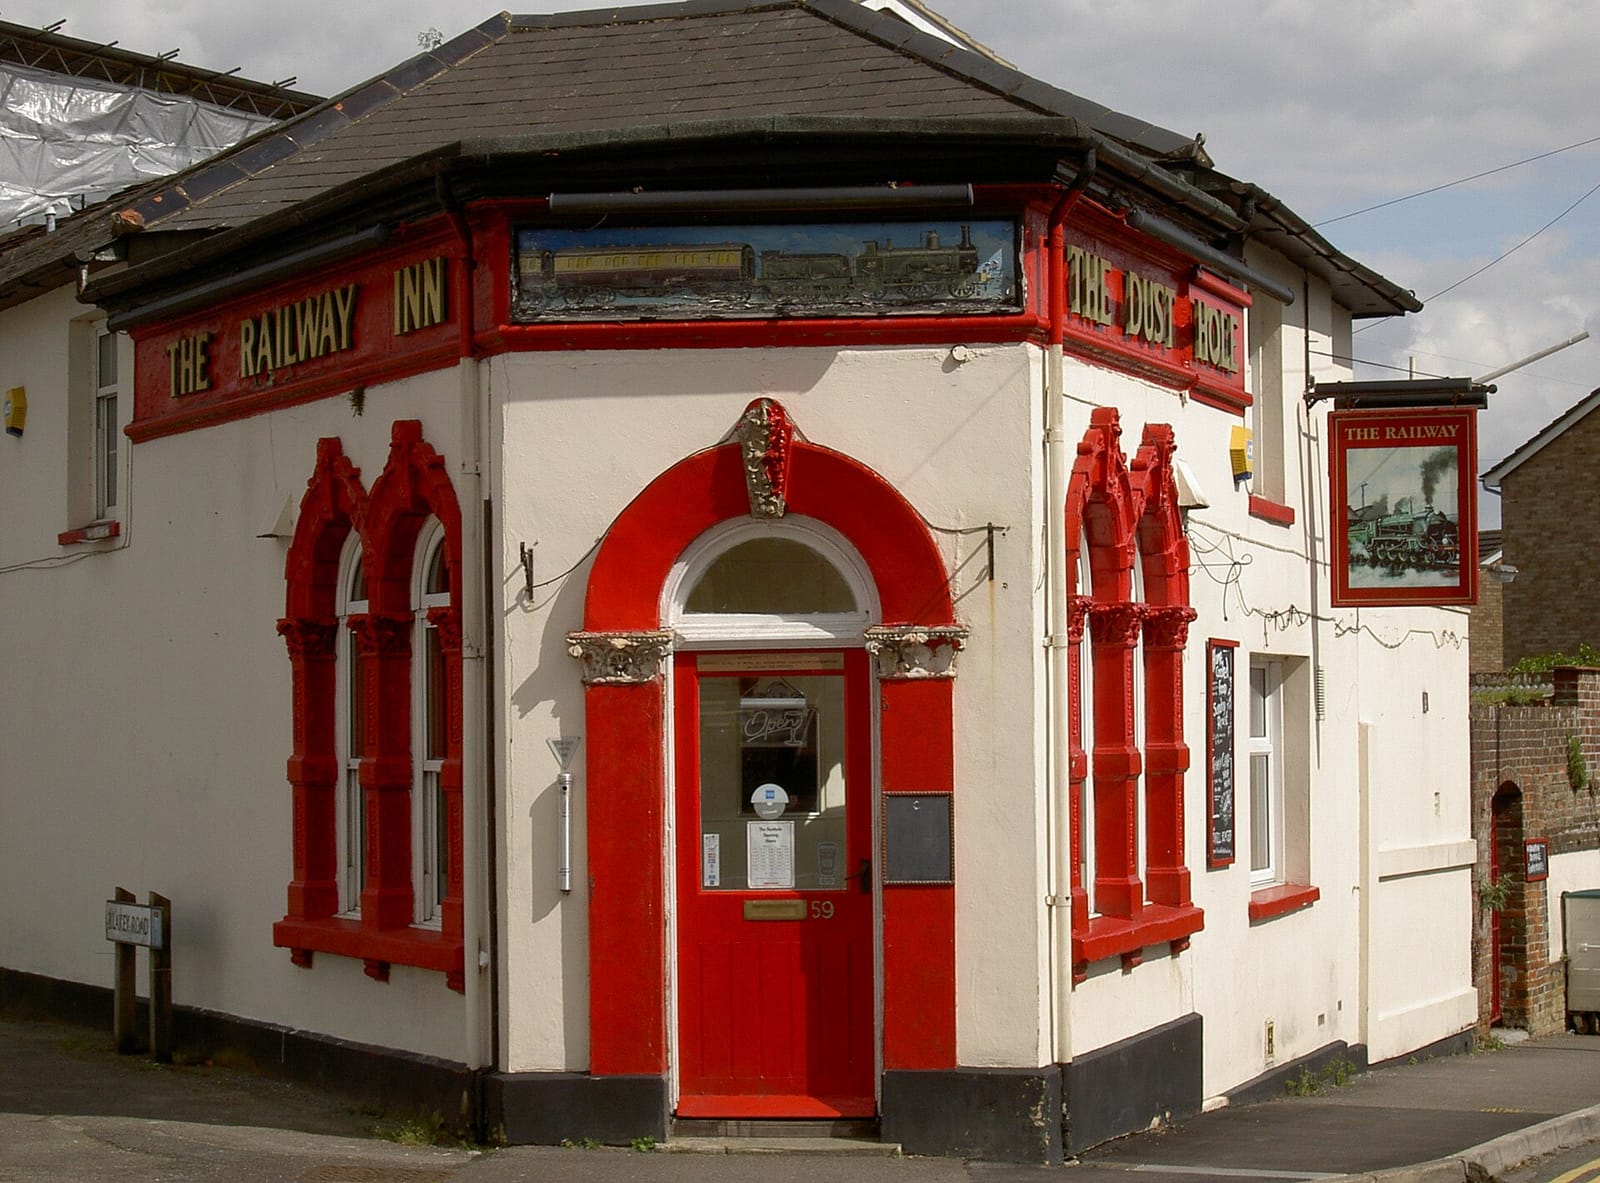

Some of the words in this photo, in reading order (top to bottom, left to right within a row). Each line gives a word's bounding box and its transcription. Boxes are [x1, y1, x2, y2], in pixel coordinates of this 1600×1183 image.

[1066, 244, 1112, 326] THE
[1124, 270, 1176, 349] DUST
[1193, 298, 1239, 374] HOLE
[167, 331, 213, 399] THE
[240, 283, 359, 379] RAILWAY
[394, 255, 446, 336] INN
[1345, 426, 1380, 441] THE
[1385, 424, 1460, 440] RAILWAY
[744, 711, 801, 742] Open
[811, 900, 835, 919] 59
